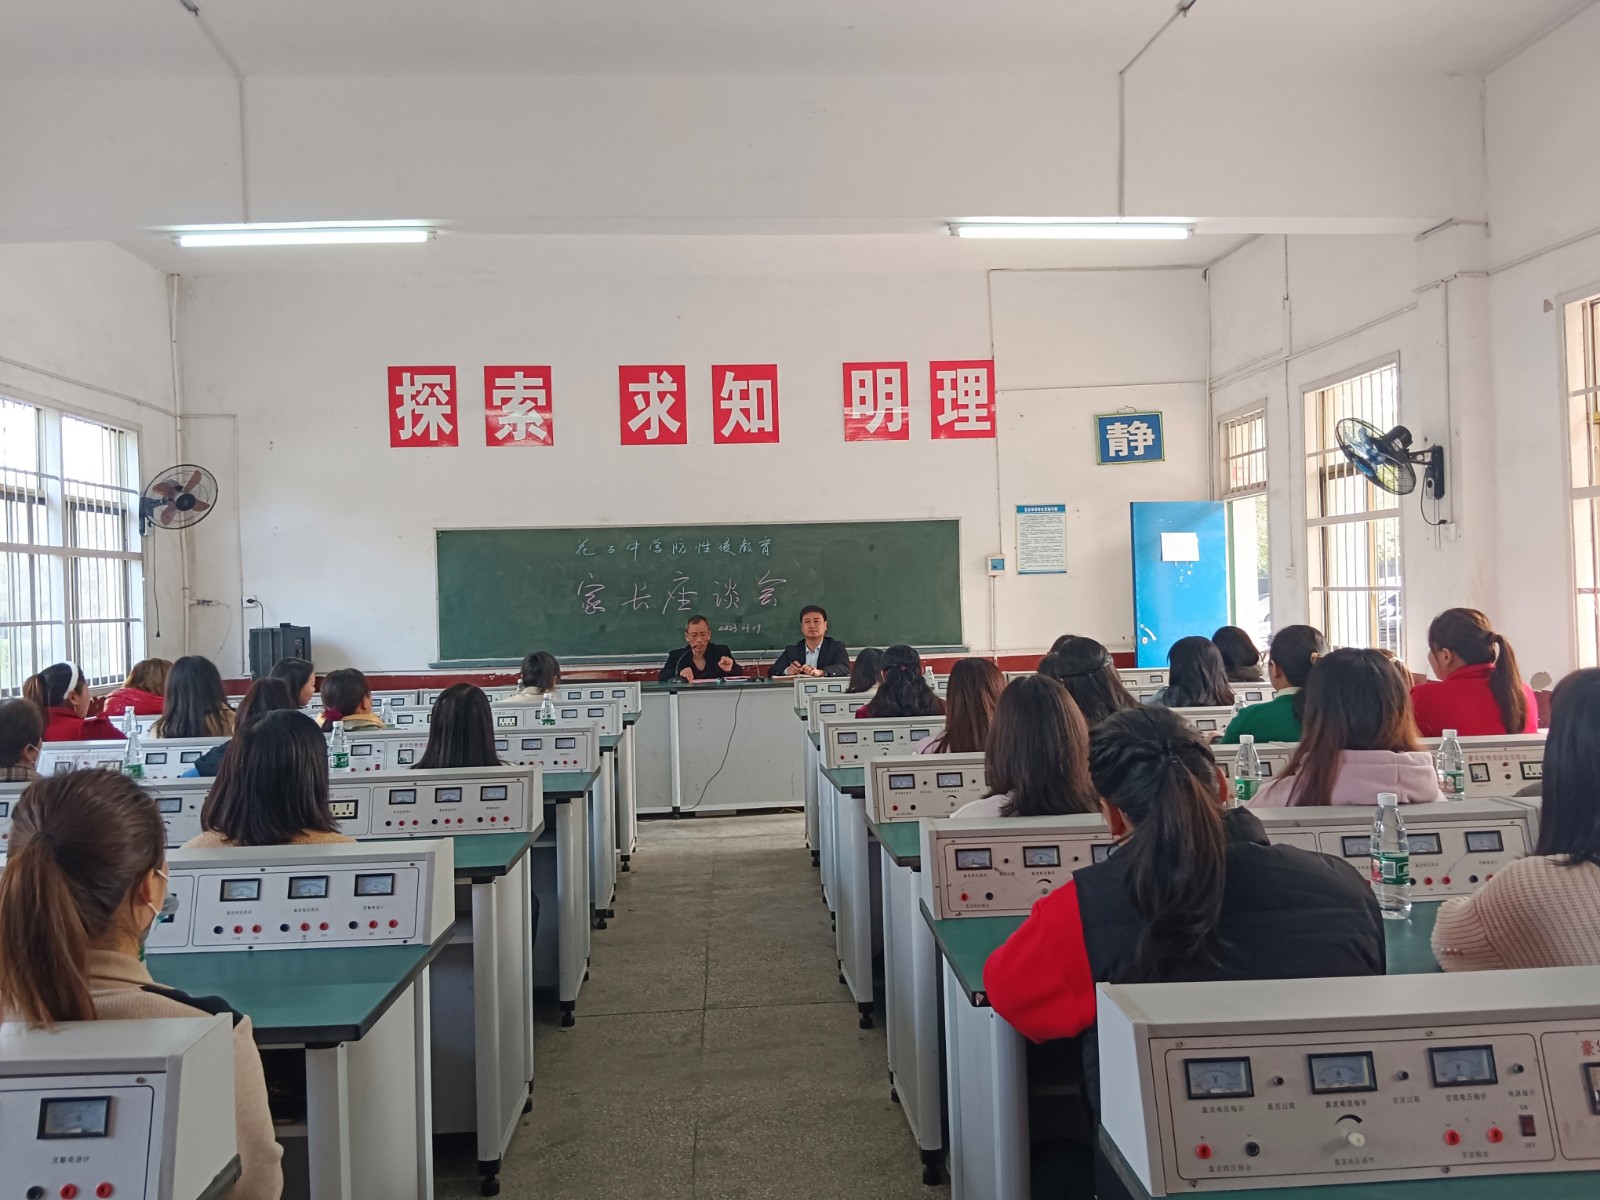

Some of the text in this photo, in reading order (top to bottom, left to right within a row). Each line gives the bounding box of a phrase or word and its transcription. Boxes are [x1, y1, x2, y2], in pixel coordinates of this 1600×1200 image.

[395, 367, 992, 441] 探索 求知 明理
[1105, 420, 1156, 457] 静
[576, 569, 788, 615] 家长座谈会
